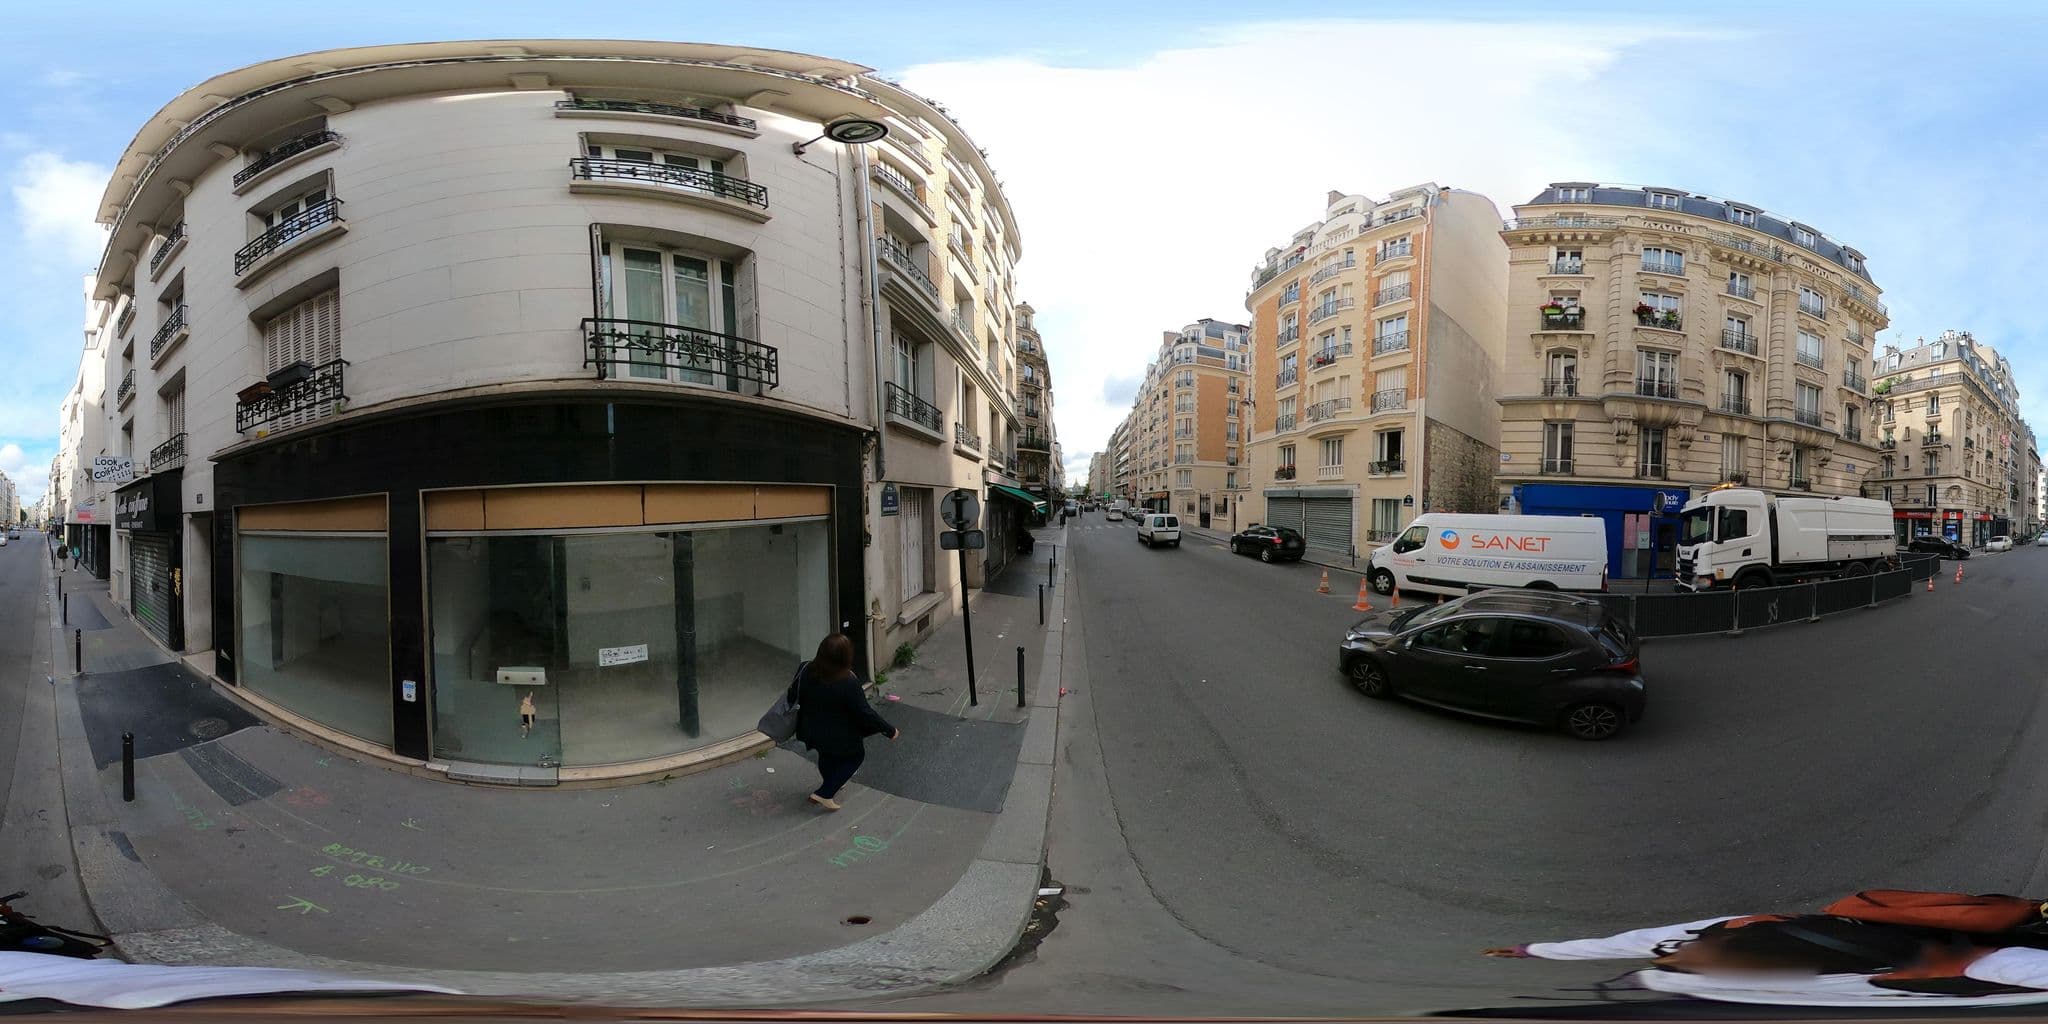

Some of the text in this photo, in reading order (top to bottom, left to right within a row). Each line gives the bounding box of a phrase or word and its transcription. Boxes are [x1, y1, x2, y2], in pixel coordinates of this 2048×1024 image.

[95, 458, 117, 466] Look
[95, 461, 130, 479] coiffure
[1471, 534, 1551, 552] SANET
[1437, 556, 1587, 573] VOTRE SOLUTION EN ASSAINISSEMENT
